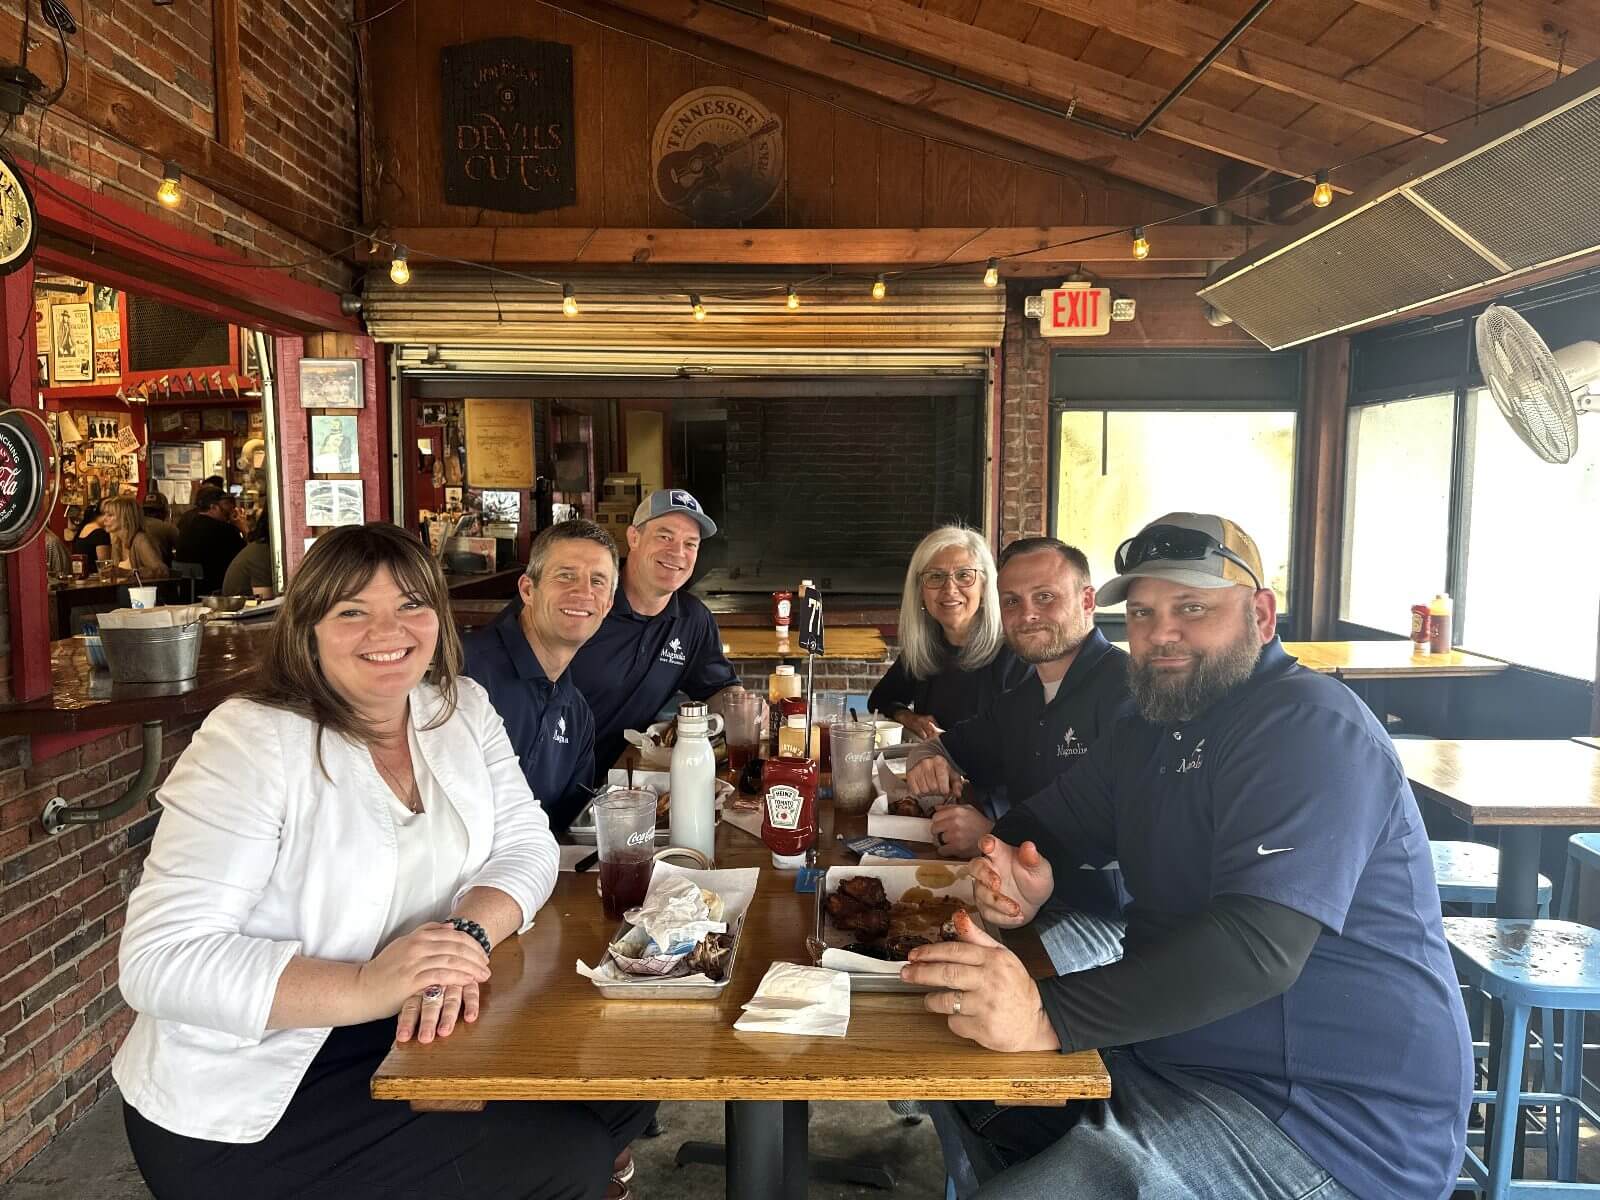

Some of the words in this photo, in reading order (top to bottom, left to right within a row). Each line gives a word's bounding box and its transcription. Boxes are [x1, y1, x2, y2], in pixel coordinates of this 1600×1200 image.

[667, 100, 758, 150] TENNESSEE
[1053, 290, 1102, 328] EXIT
[775, 790, 793, 798] HEINZ
